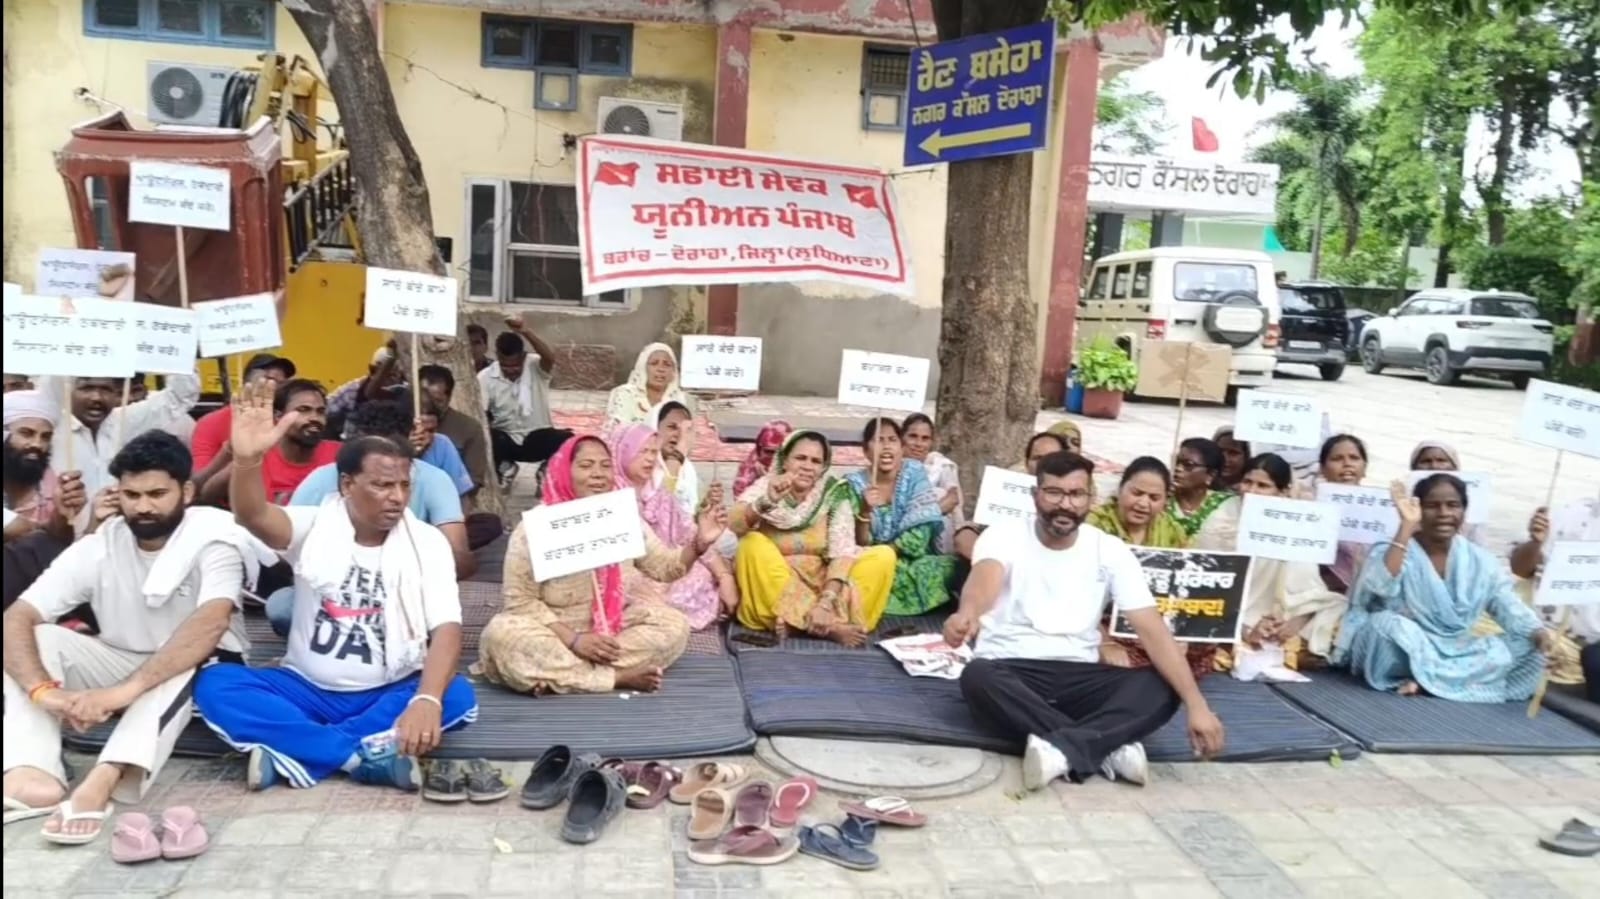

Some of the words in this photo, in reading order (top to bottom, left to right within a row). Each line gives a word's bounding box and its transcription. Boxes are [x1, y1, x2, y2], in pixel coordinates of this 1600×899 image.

[916, 50, 958, 92] ਰੈਣ
[969, 37, 1043, 80] ਬਸੇਰਾ
[912, 102, 947, 126] ਨਗਰ
[759, 168, 828, 197] ਸੇਵਕ
[1087, 161, 1146, 190] ਨਗਰ
[631, 197, 770, 240] ਯੂਨੀਅਨ
[775, 202, 857, 239] ਪੰਜਾਬ
